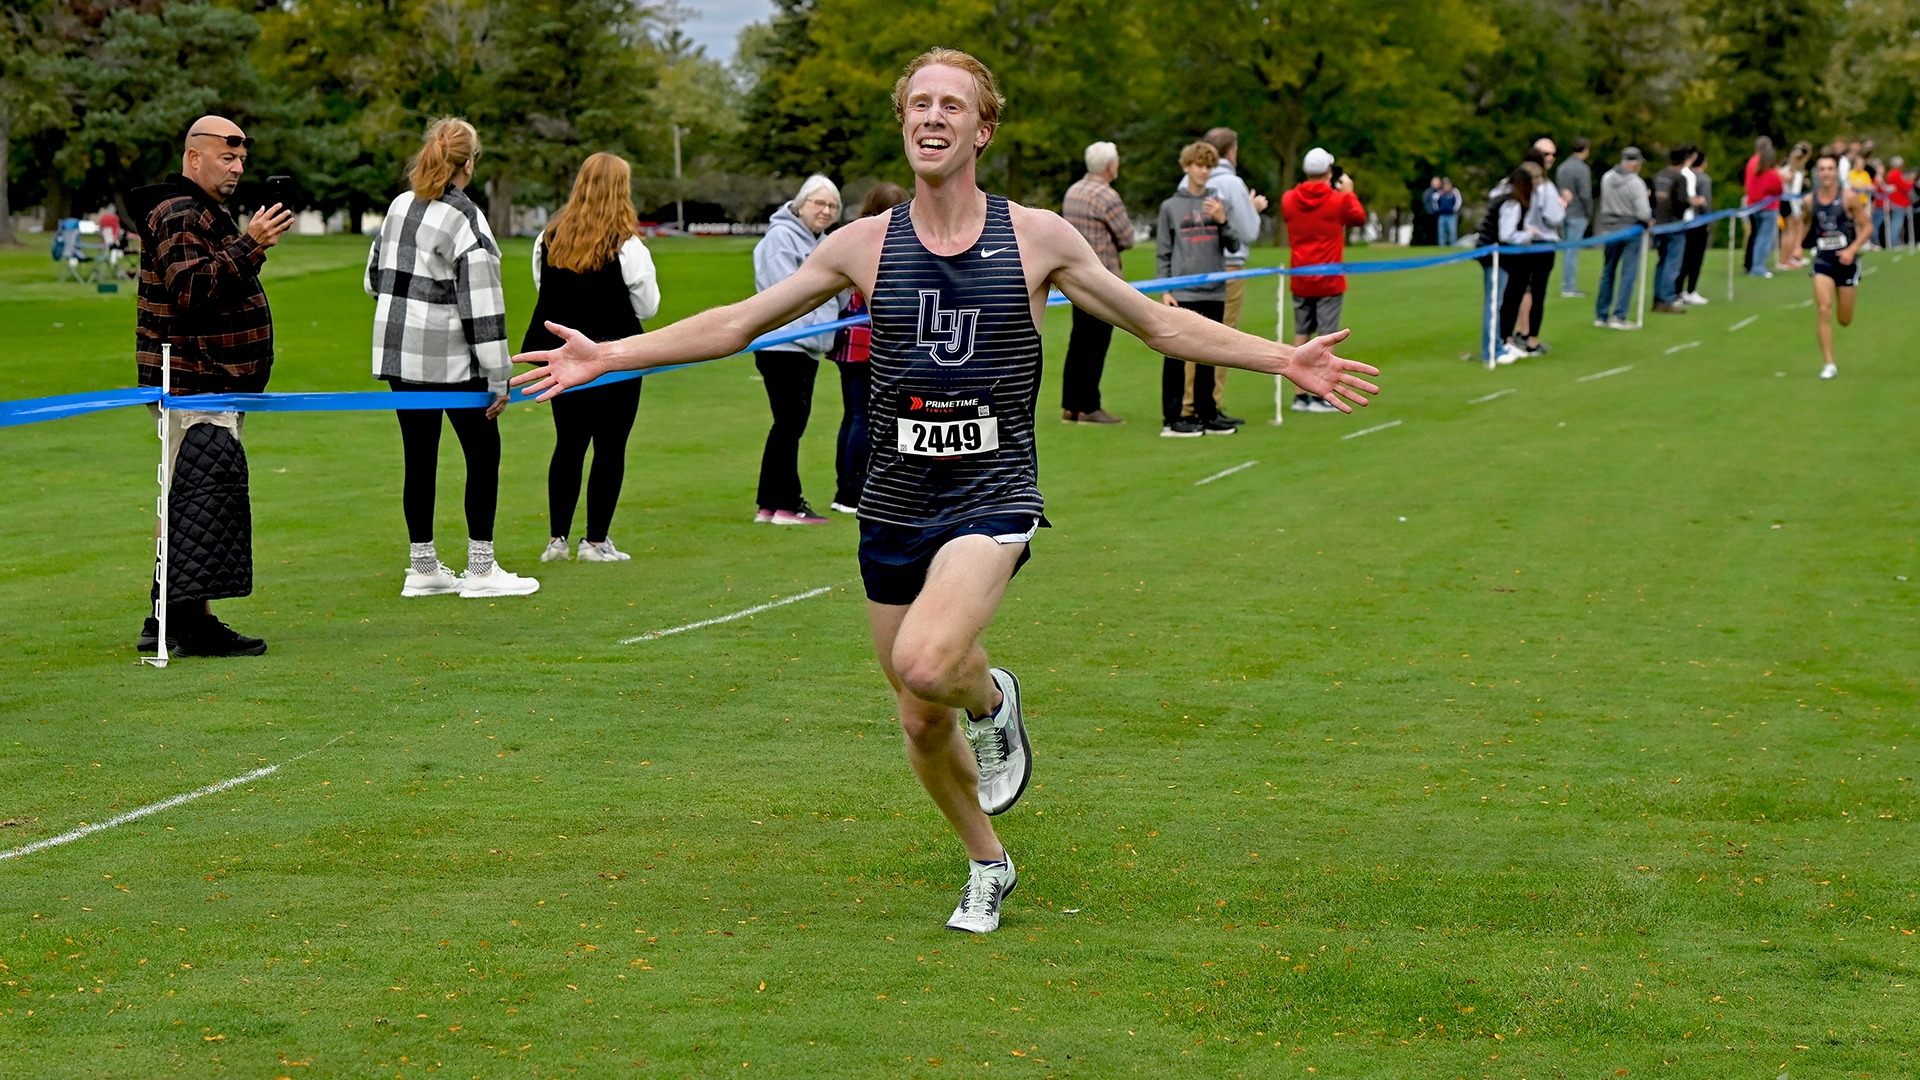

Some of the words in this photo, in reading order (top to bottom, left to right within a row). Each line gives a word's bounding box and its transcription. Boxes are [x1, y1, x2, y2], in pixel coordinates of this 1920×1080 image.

[916, 289, 981, 366] LU
[925, 398, 979, 408] PRIMETIME
[912, 421, 982, 453] 2449
